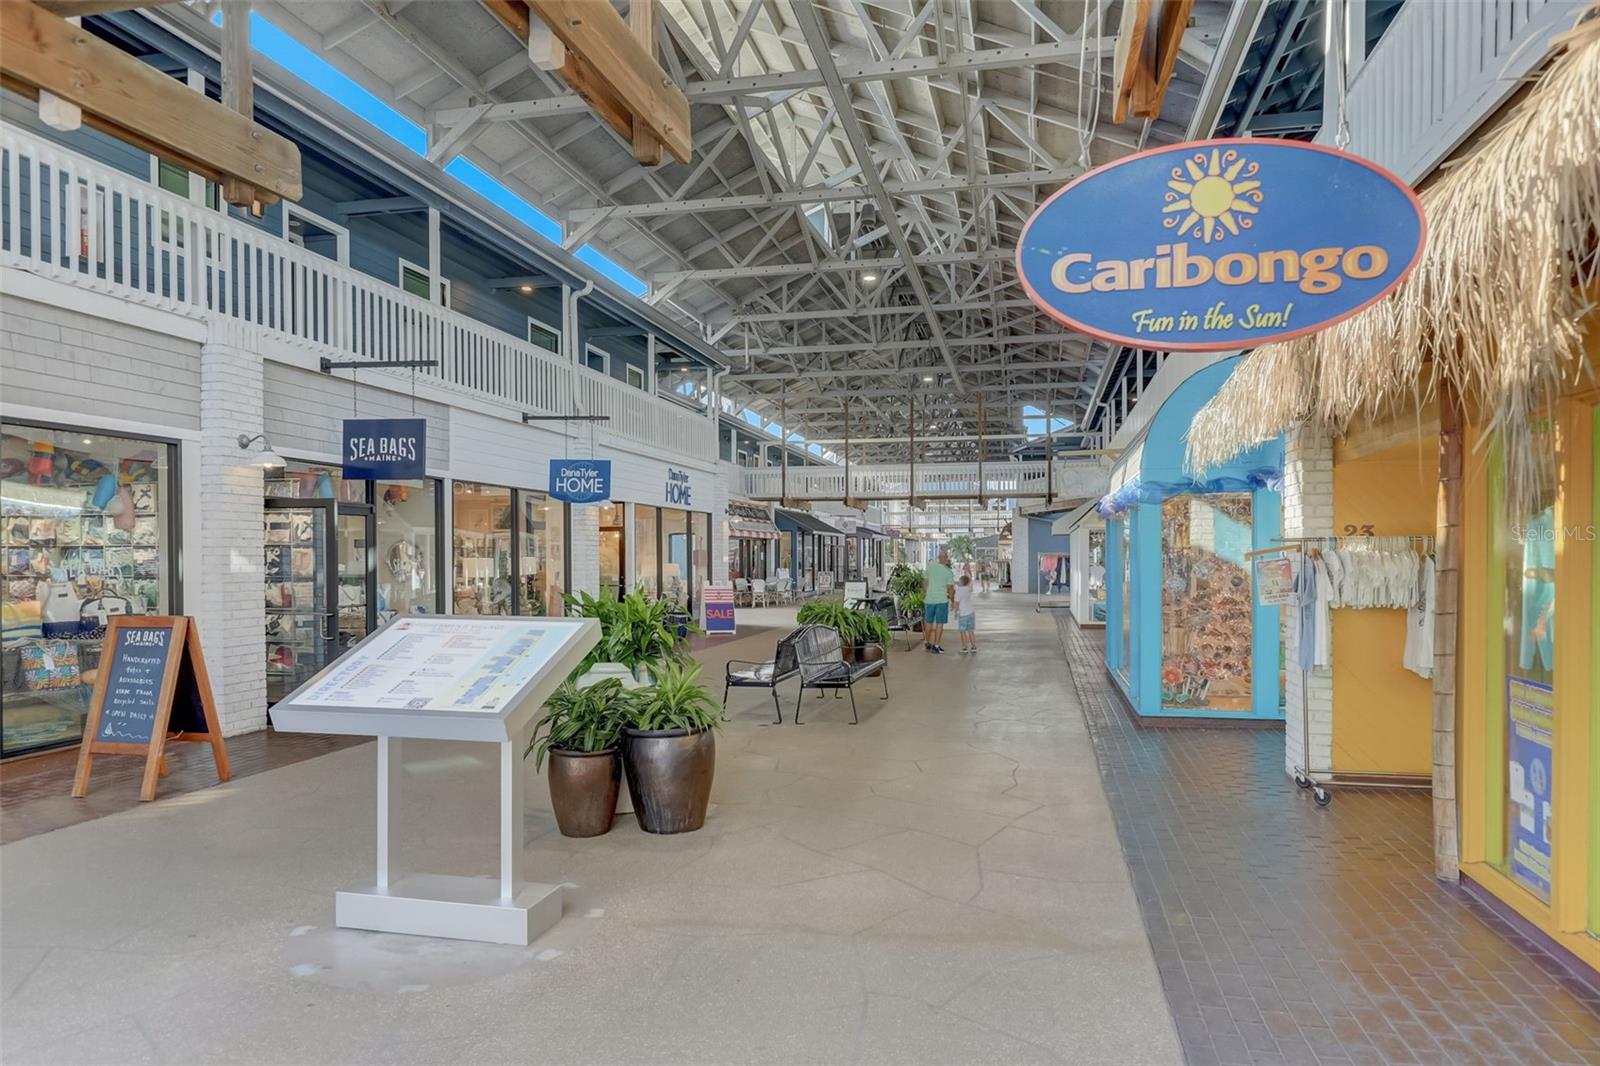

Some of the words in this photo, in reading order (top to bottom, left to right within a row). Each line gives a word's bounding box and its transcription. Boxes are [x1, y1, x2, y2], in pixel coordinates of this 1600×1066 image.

[1051, 242, 1389, 295] Caribongo
[1132, 308, 1173, 333] Fun
[1178, 310, 1198, 331] in
[1203, 302, 1234, 330] the
[1239, 303, 1293, 330] Sun!
[350, 437, 375, 461] SEA
[380, 437, 416, 461] BAGS
[556, 478, 603, 493] HOME
[665, 482, 692, 506] HOME
[706, 608, 733, 619] SALE
[125, 631, 141, 646] SEA
[142, 631, 165, 647] BAGS
[306, 654, 369, 701] DIRECTORY
